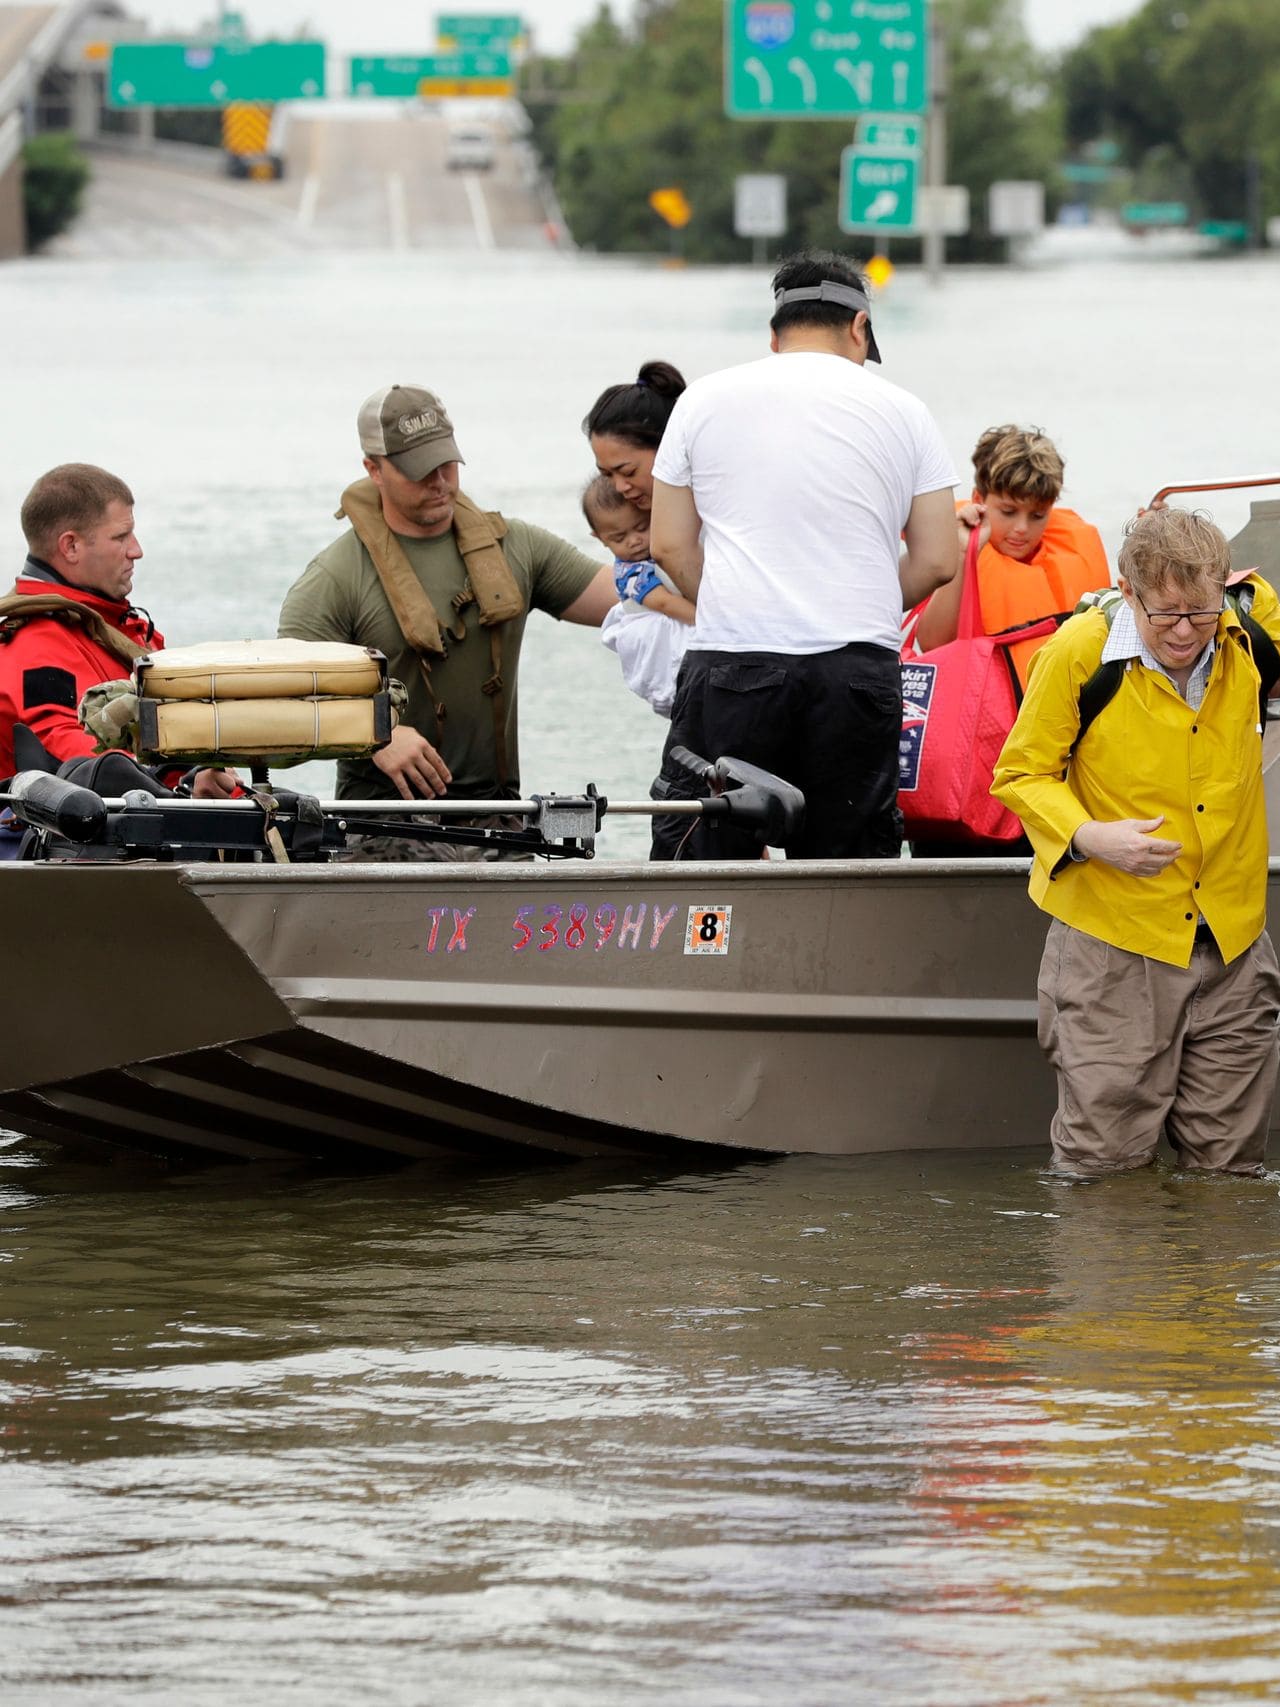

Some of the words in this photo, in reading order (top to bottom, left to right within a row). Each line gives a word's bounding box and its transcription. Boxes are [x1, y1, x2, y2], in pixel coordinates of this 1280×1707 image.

[901, 669, 932, 681] kin'
[427, 904, 477, 954] TX
[700, 913, 718, 941] 8
